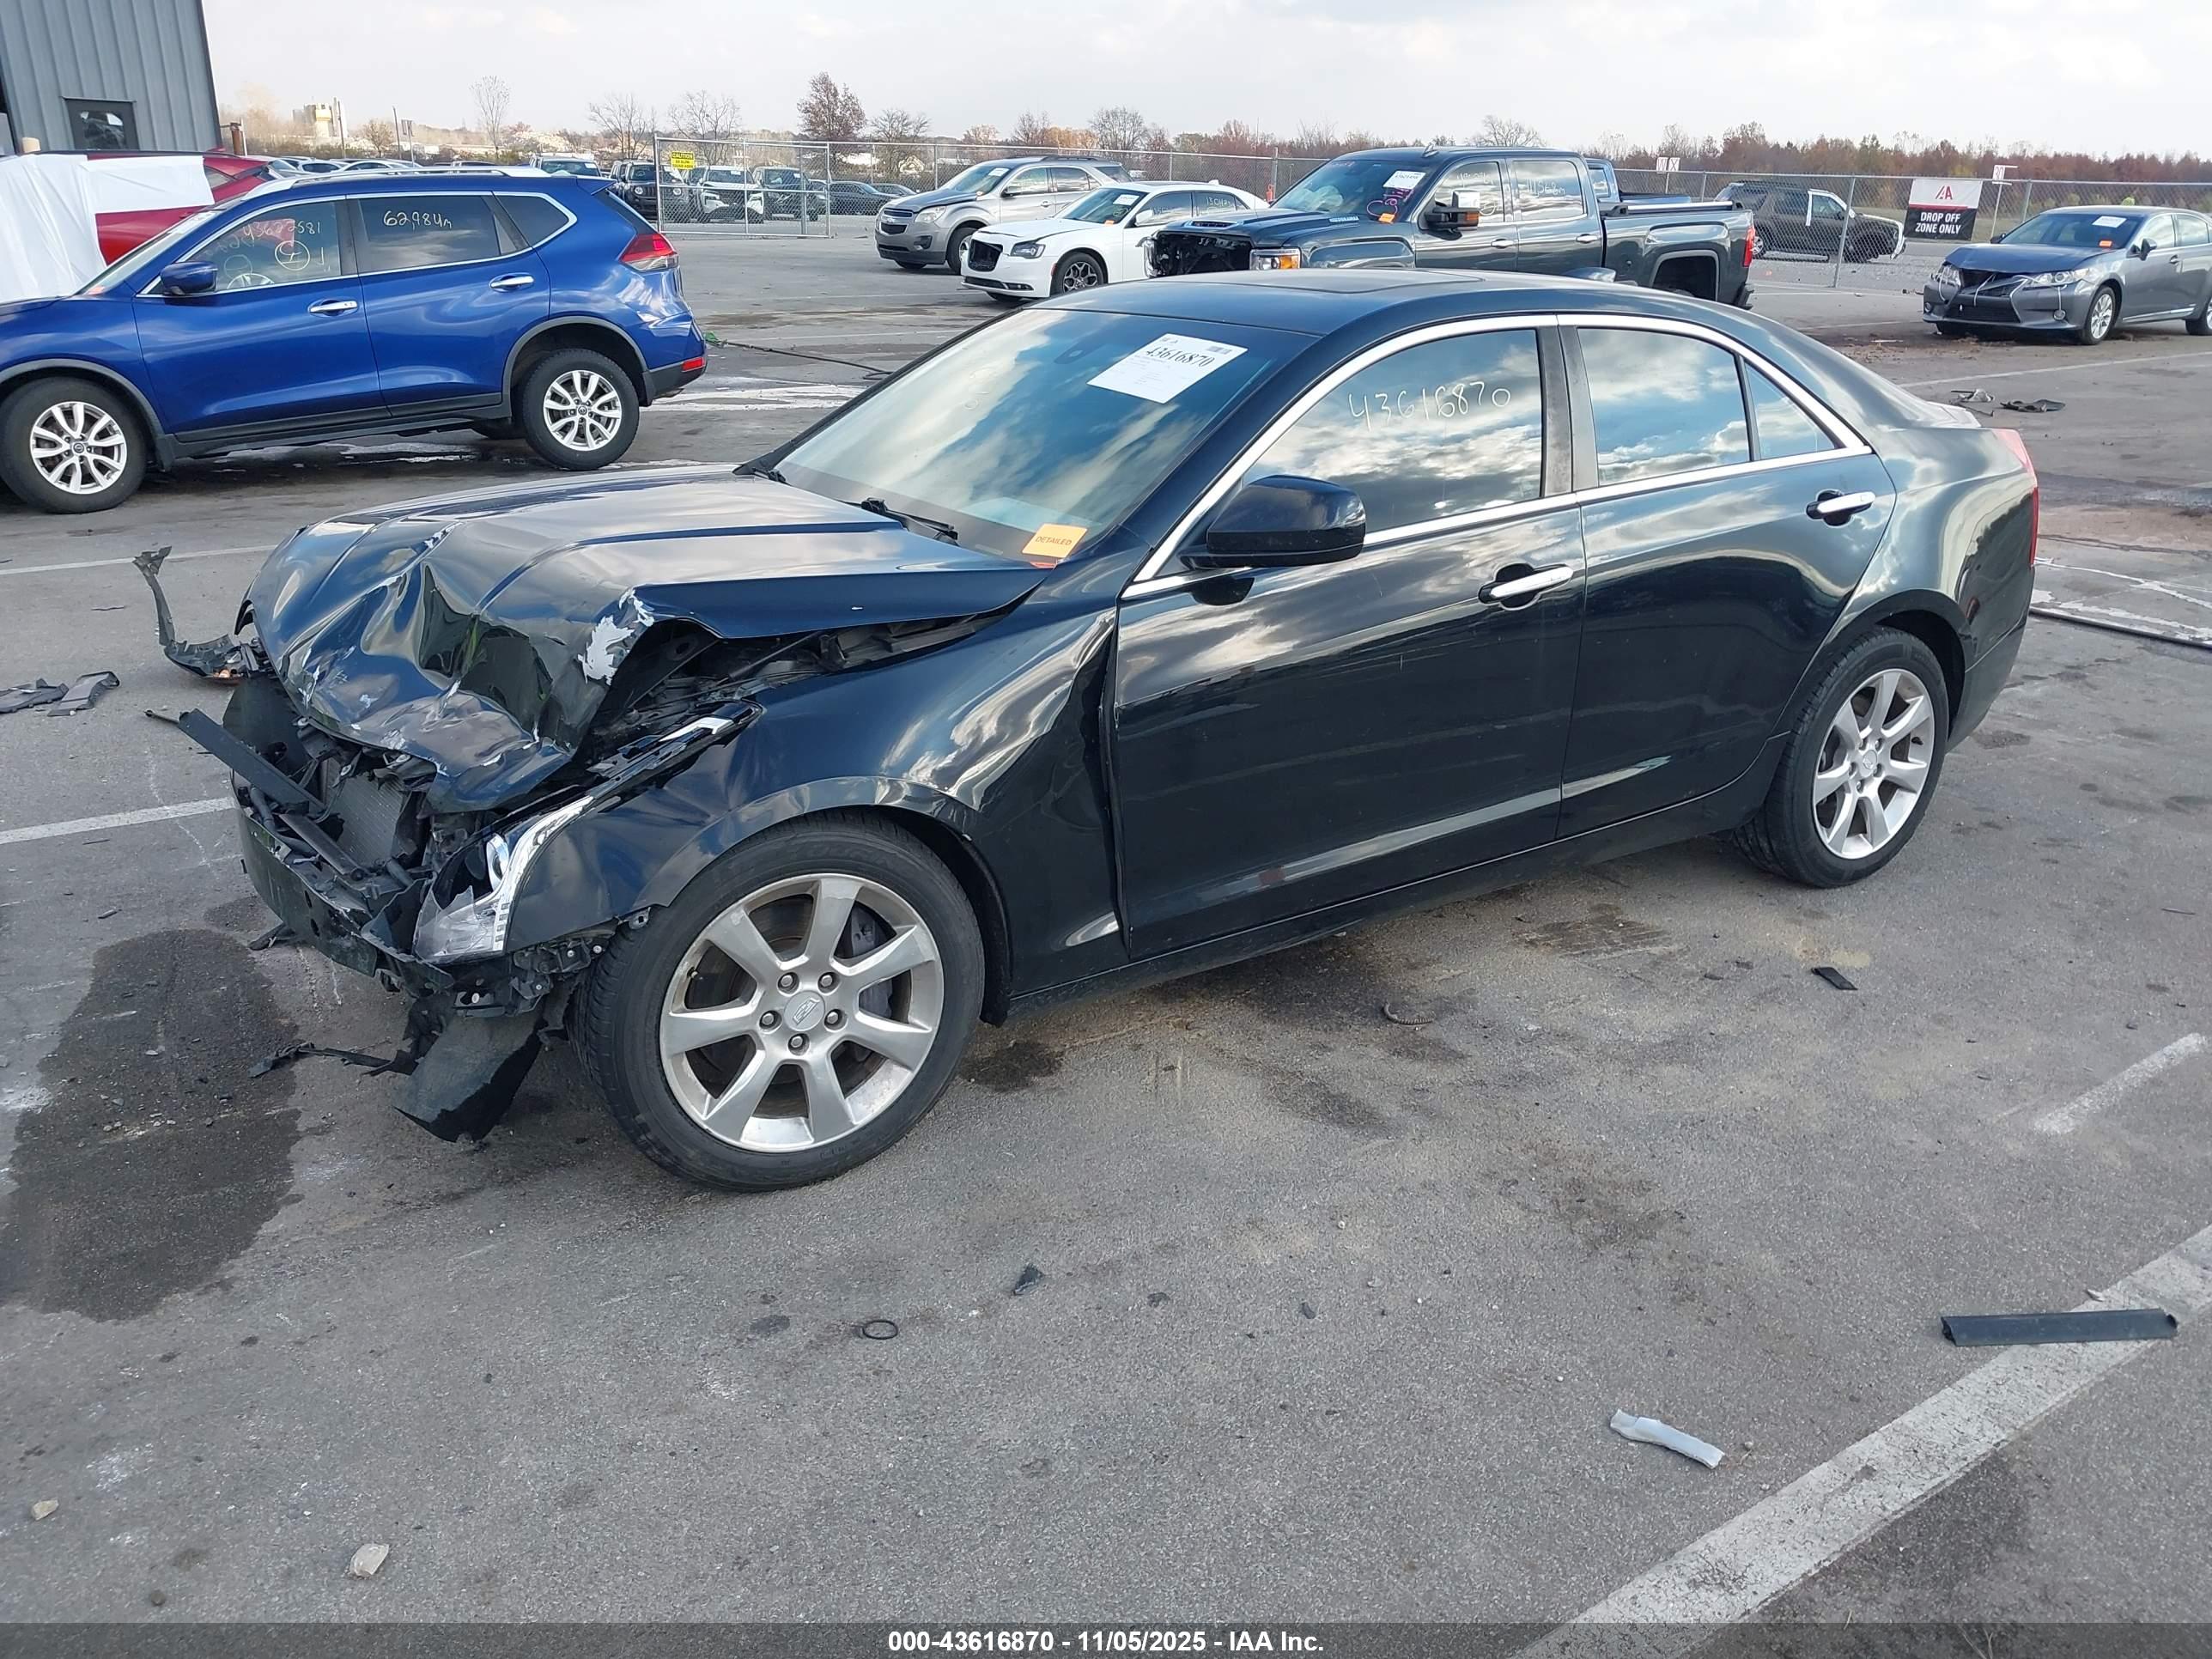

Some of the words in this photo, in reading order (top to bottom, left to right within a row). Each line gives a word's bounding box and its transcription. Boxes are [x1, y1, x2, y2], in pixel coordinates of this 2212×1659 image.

[1670, 158, 1678, 171] X
[1920, 211, 1944, 223] DROP
[1945, 213, 1961, 223] OFF
[1915, 222, 1938, 234] ZONE
[1939, 223, 1961, 234] ONLY
[1146, 345, 1216, 368] 43616870
[1348, 381, 1511, 432] 43616870
[1035, 535, 1073, 546] DETAILED
